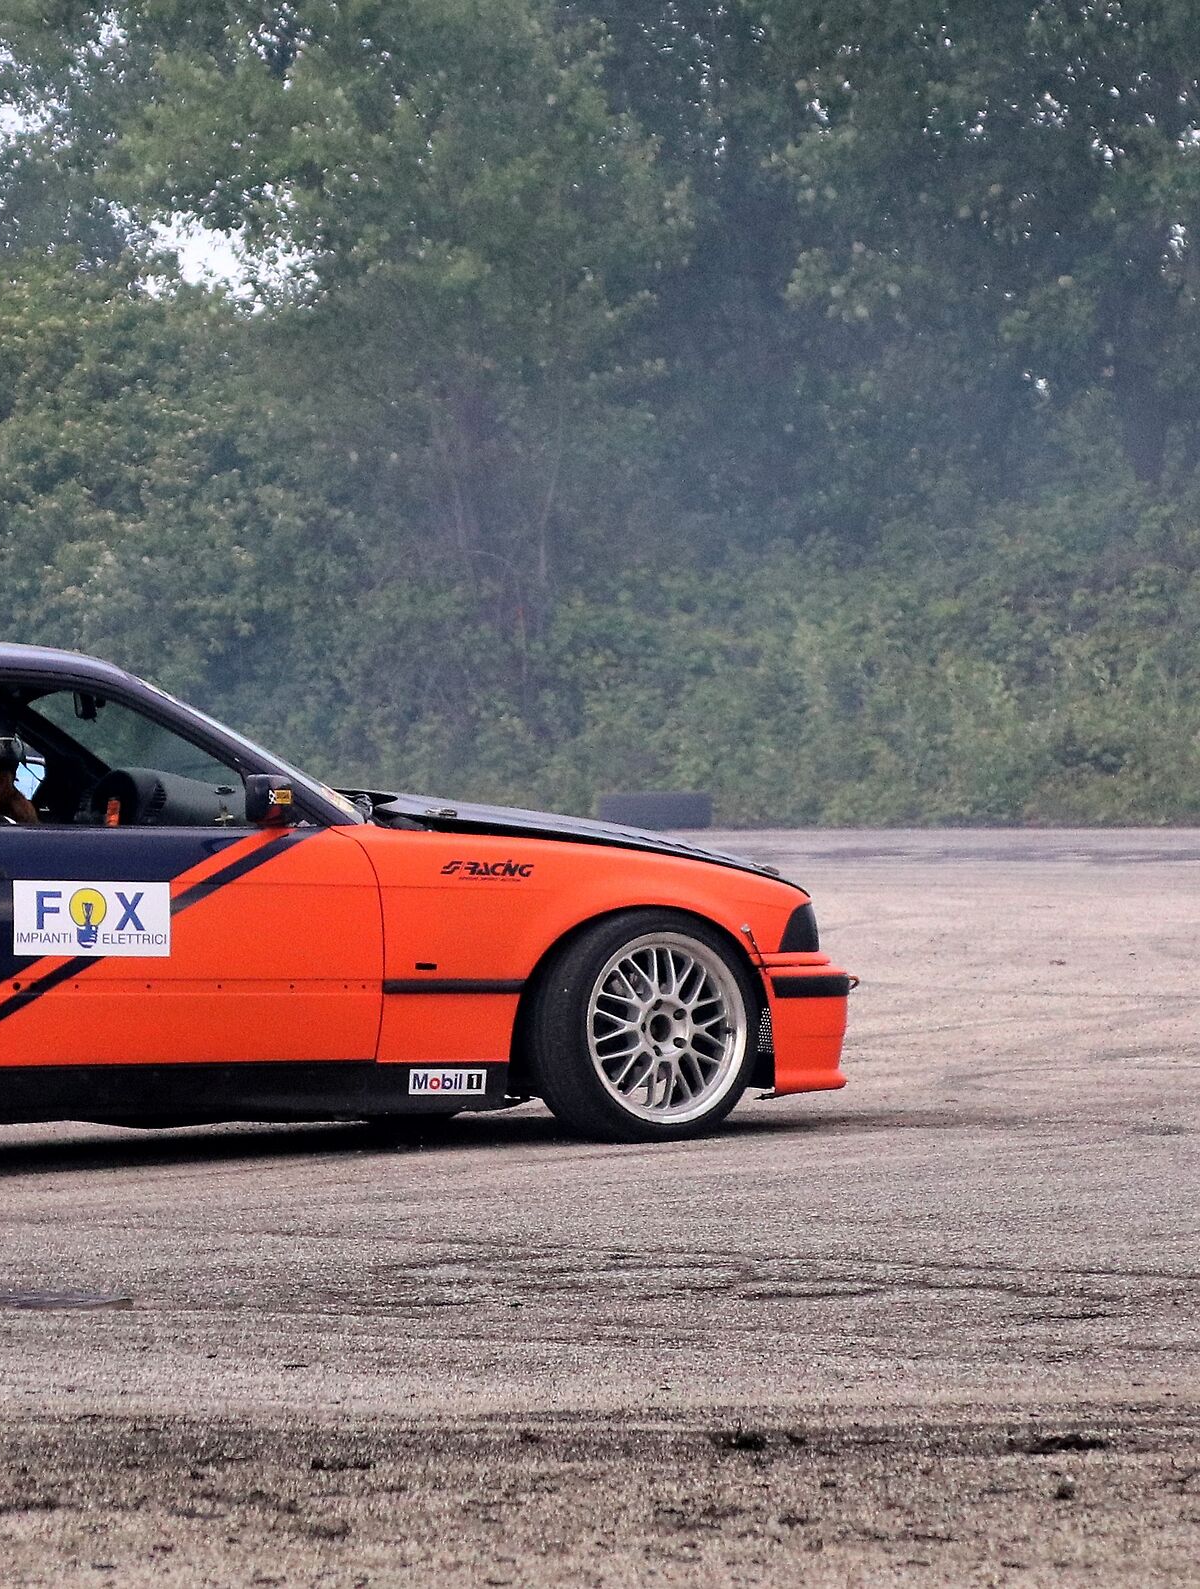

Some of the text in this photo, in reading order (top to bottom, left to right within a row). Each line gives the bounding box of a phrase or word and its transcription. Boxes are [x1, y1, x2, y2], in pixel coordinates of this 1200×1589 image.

[36, 888, 146, 932] FOX
[16, 932, 167, 945] IMPIANTI ELETTRICI
[412, 1073, 481, 1090] Mobil 1
